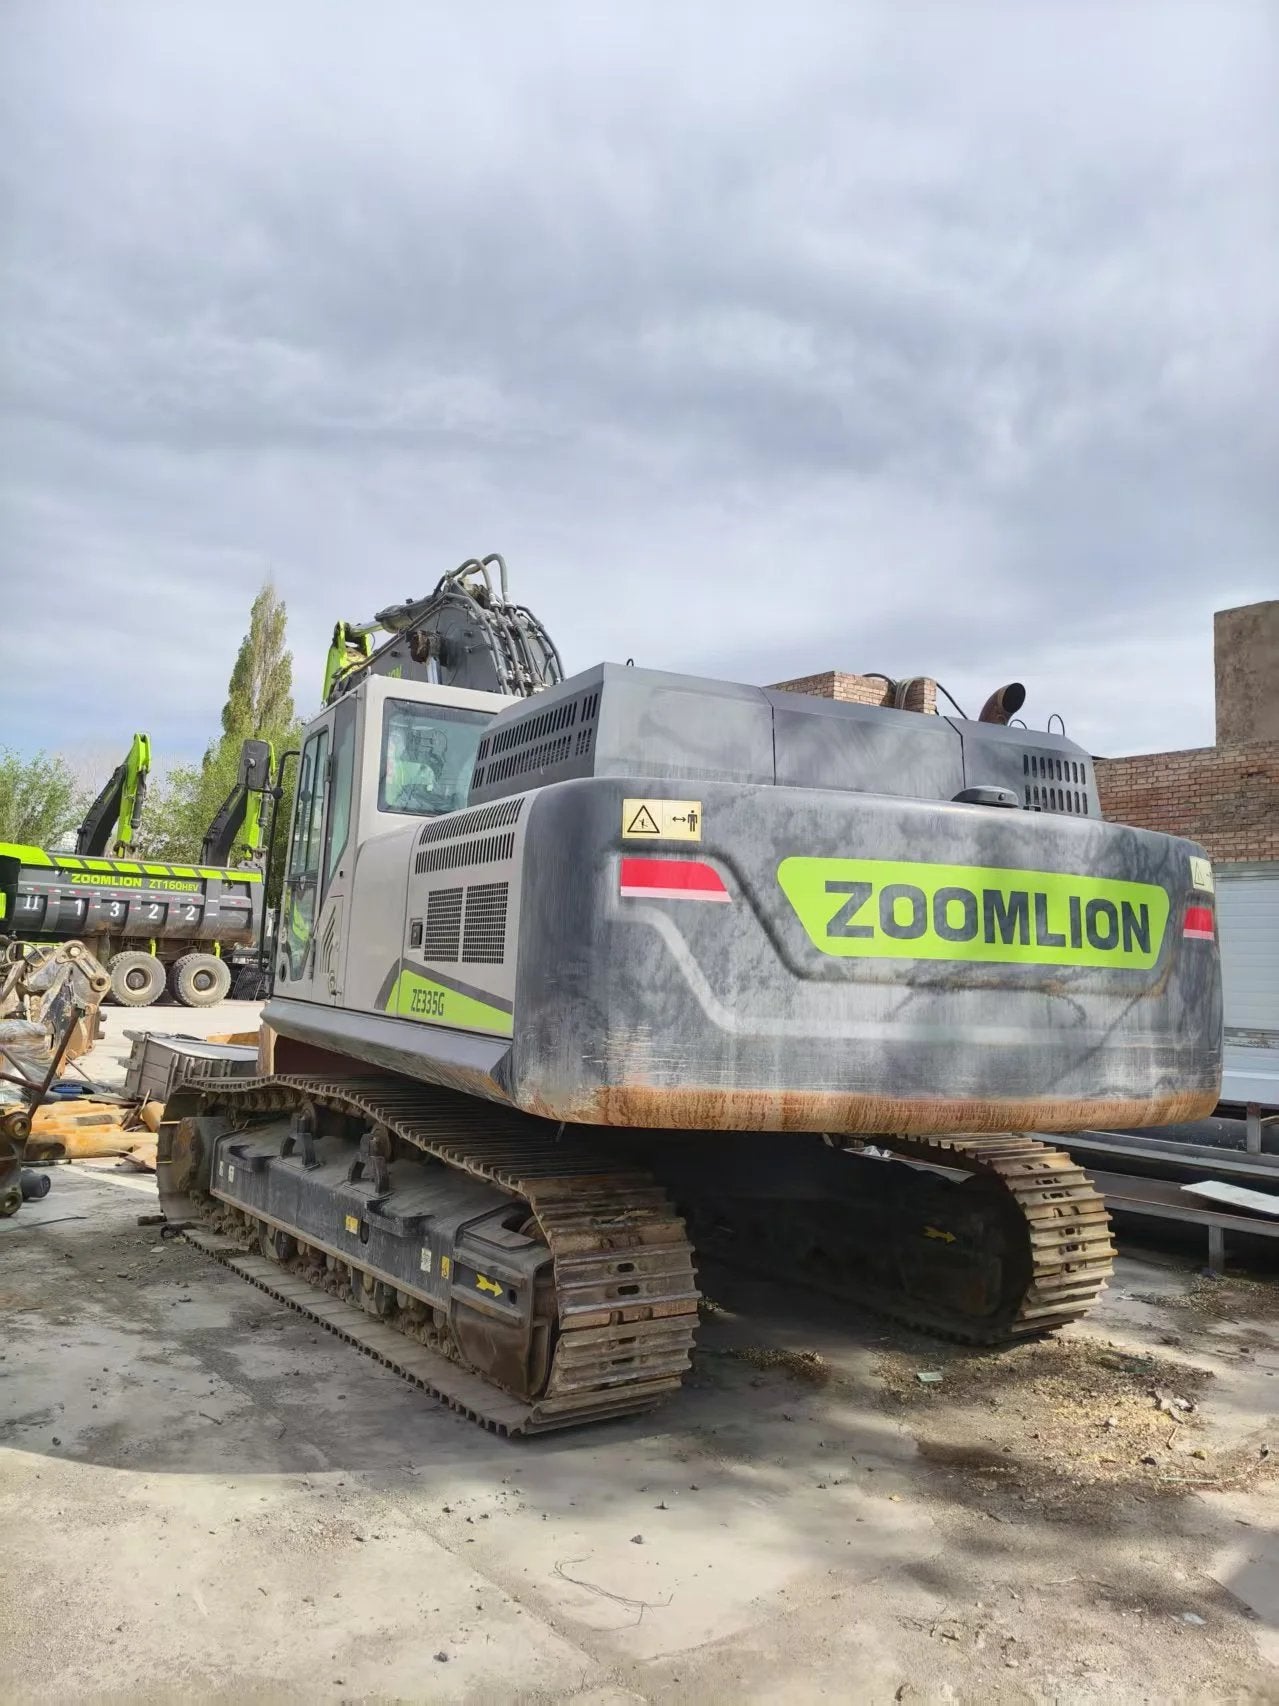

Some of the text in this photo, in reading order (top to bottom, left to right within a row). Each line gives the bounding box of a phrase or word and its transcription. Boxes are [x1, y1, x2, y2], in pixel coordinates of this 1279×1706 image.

[71, 873, 199, 892] ZOOMLION ZT160HEV
[110, 901, 120, 917] 3
[148, 903, 159, 919] 2
[185, 905, 196, 920] 2
[825, 880, 1151, 954] ZOOMLION
[411, 988, 445, 1016] ZE335G
